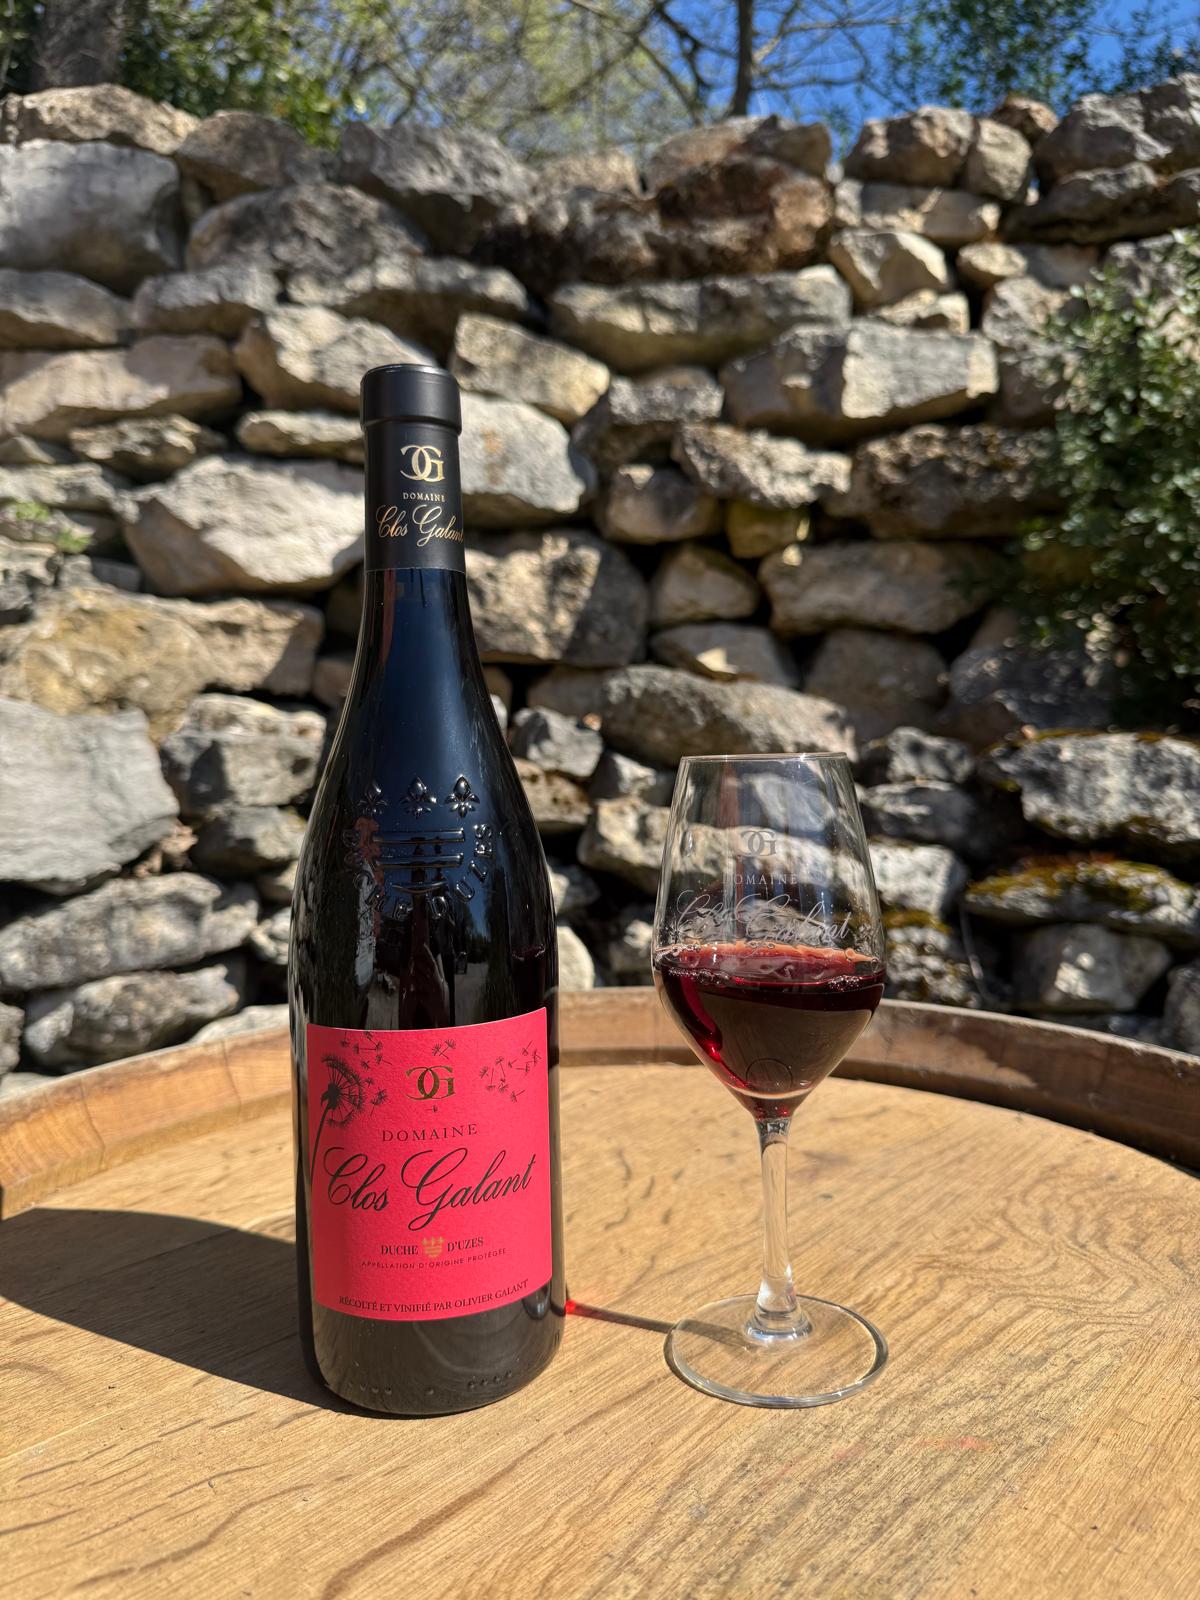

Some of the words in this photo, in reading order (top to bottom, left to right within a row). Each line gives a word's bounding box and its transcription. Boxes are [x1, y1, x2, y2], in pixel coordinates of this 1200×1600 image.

[403, 491, 446, 503] DOMAINE
[376, 504, 409, 539] Clos
[382, 1123, 479, 1142] DOMAINE
[323, 1147, 389, 1211] Clos
[401, 1147, 536, 1231] Galant
[361, 1260, 415, 1270] APPELLATION
[418, 1257, 465, 1269] D'ORIGINE
[338, 1295, 378, 1311] RÉCOLTÉ
[379, 1303, 392, 1312] ET
[393, 1301, 431, 1312] VINIFIÉ
[433, 1301, 452, 1311] PAR
[454, 1293, 494, 1308] OLIVIER
[494, 1278, 529, 1299] GALANT
